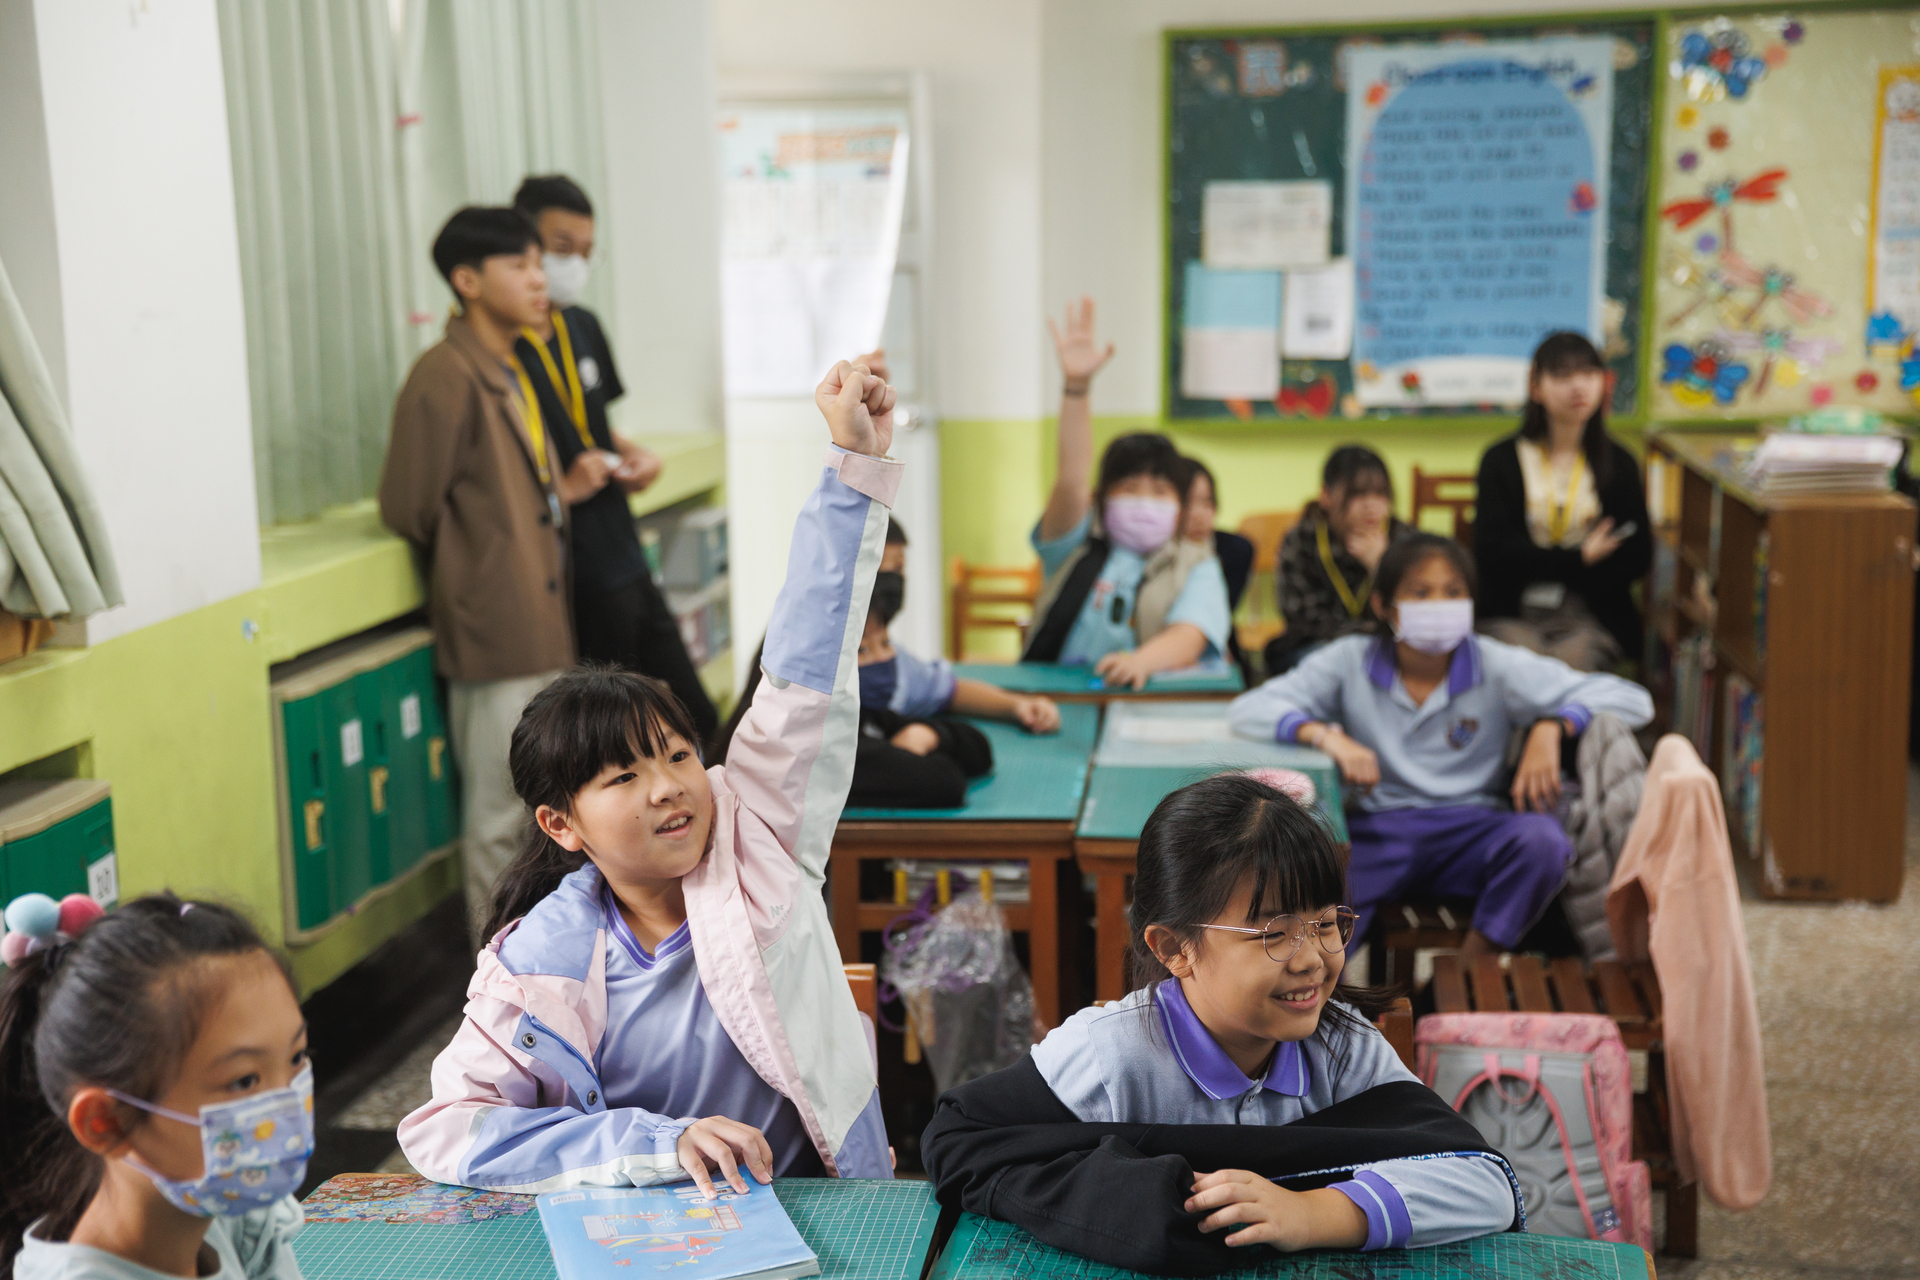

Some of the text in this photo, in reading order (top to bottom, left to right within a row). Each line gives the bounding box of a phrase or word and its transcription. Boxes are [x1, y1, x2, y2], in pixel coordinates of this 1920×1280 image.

[1383, 56, 1578, 86] Classroom English
[95, 868, 113, 900] 10
[775, 902, 793, 930] QUECH
